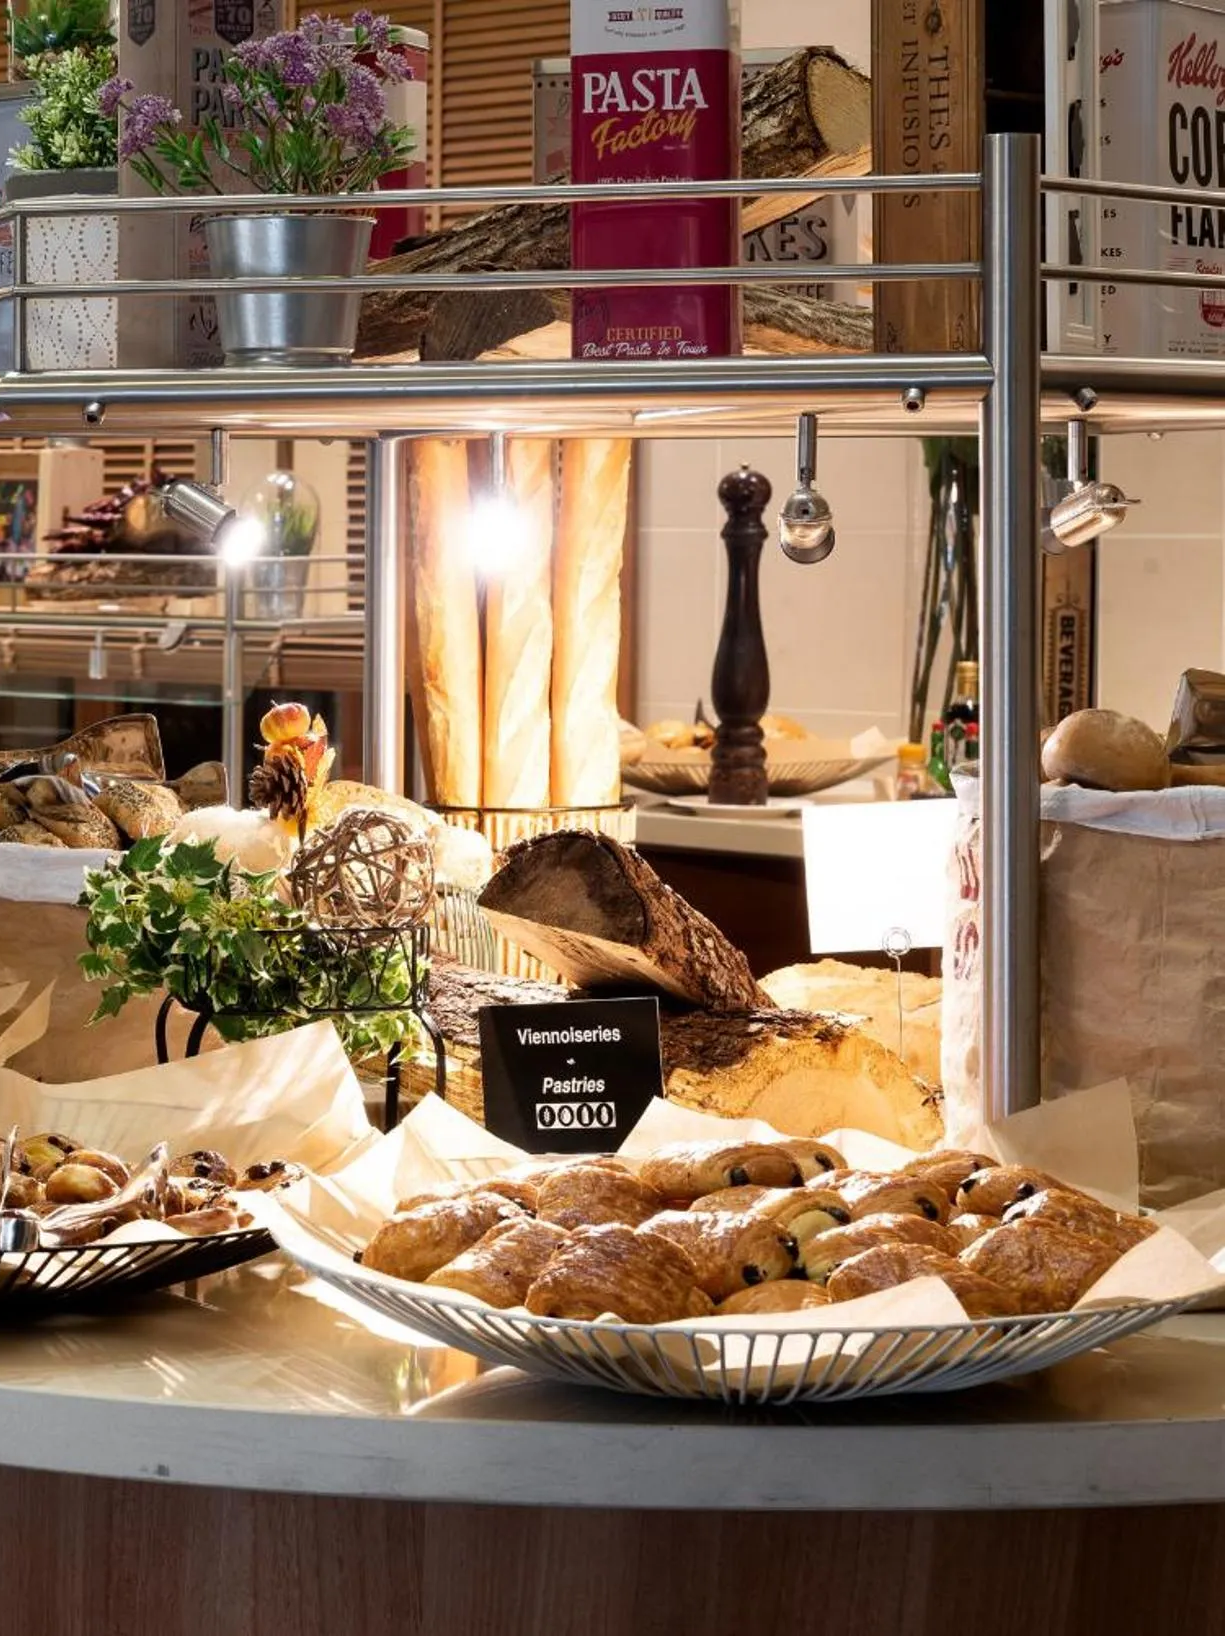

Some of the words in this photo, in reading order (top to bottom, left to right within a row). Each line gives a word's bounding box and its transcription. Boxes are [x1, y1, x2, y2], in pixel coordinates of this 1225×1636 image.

[582, 68, 709, 113] PASTA
[928, 45, 951, 150] THES
[591, 108, 698, 161] Factory
[902, 40, 921, 209] INFUSIOS
[582, 342, 612, 357] Best
[615, 341, 652, 357] Pasta
[676, 340, 709, 357] Town
[606, 326, 682, 341] CERTIFIED
[516, 1025, 622, 1046] Viennoiseries
[542, 1076, 606, 1095] Pastries
